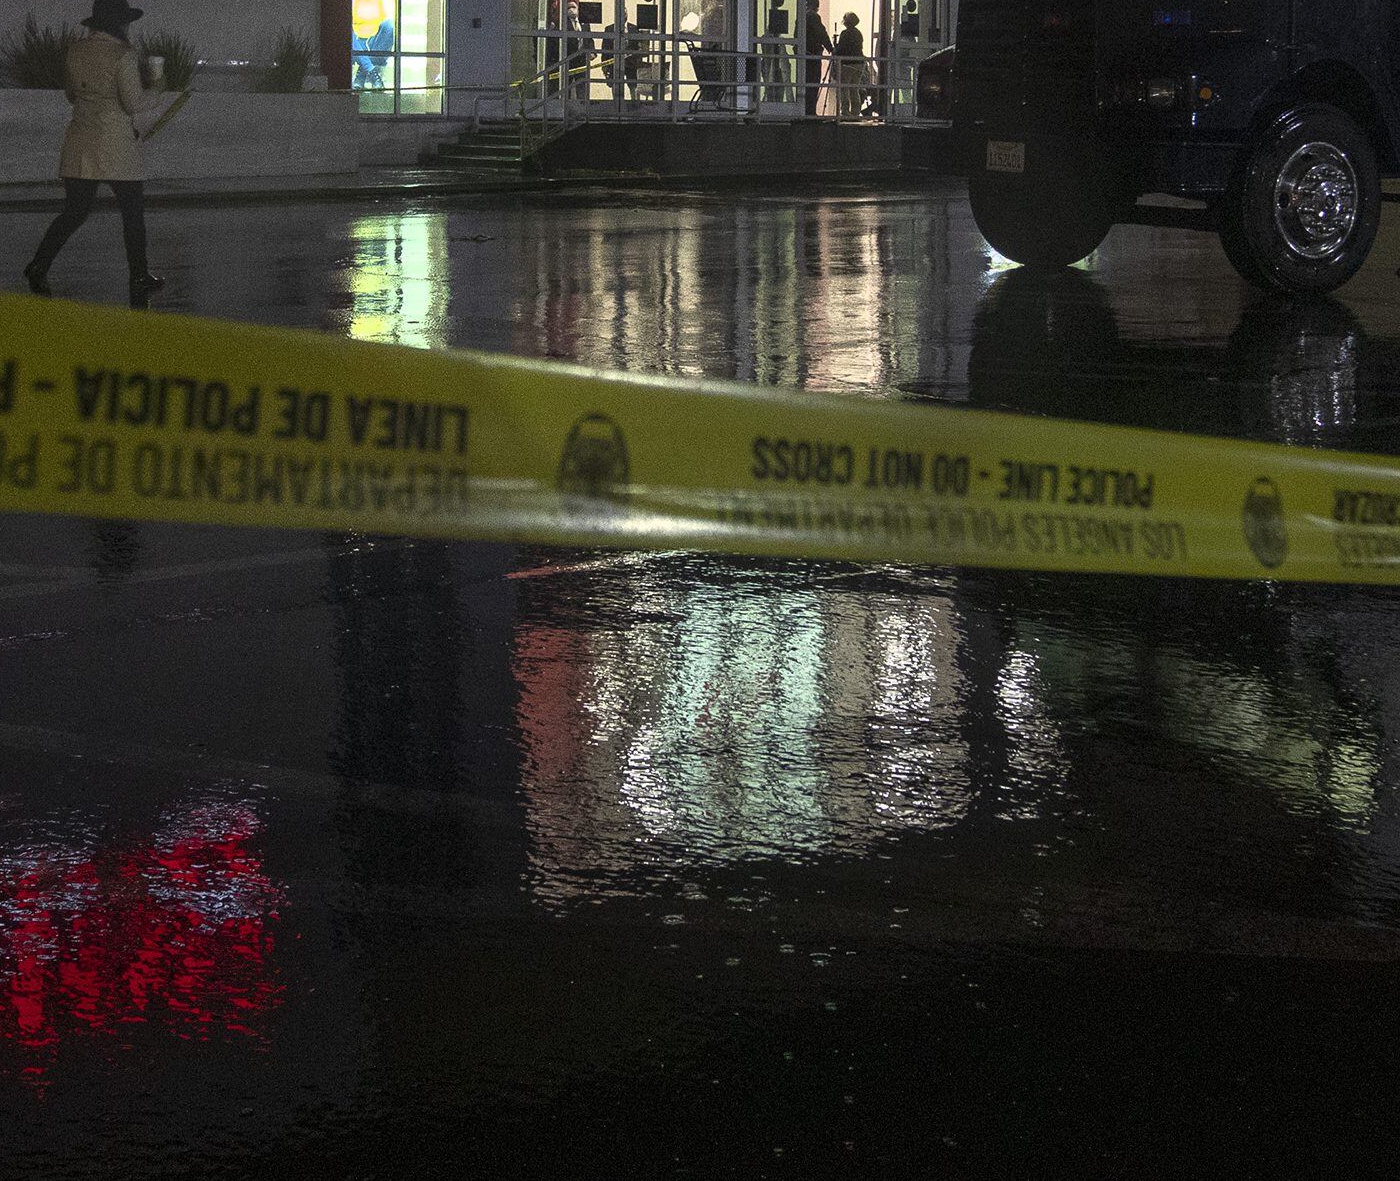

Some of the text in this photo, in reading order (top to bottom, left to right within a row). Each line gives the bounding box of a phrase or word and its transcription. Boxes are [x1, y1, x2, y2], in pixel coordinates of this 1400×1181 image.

[74, 365, 260, 436] POLICIA
[276, 388, 332, 443] DE
[345, 395, 470, 454] LINEA
[57, 432, 117, 495] DE
[750, 435, 856, 483] CROSS
[865, 447, 923, 490] NOT
[931, 454, 971, 498] DO
[998, 458, 1061, 504] LINE
[1066, 461, 1156, 511] POLICE
[1022, 511, 1139, 556] ANGELES
[1143, 521, 1190, 562] LOS
